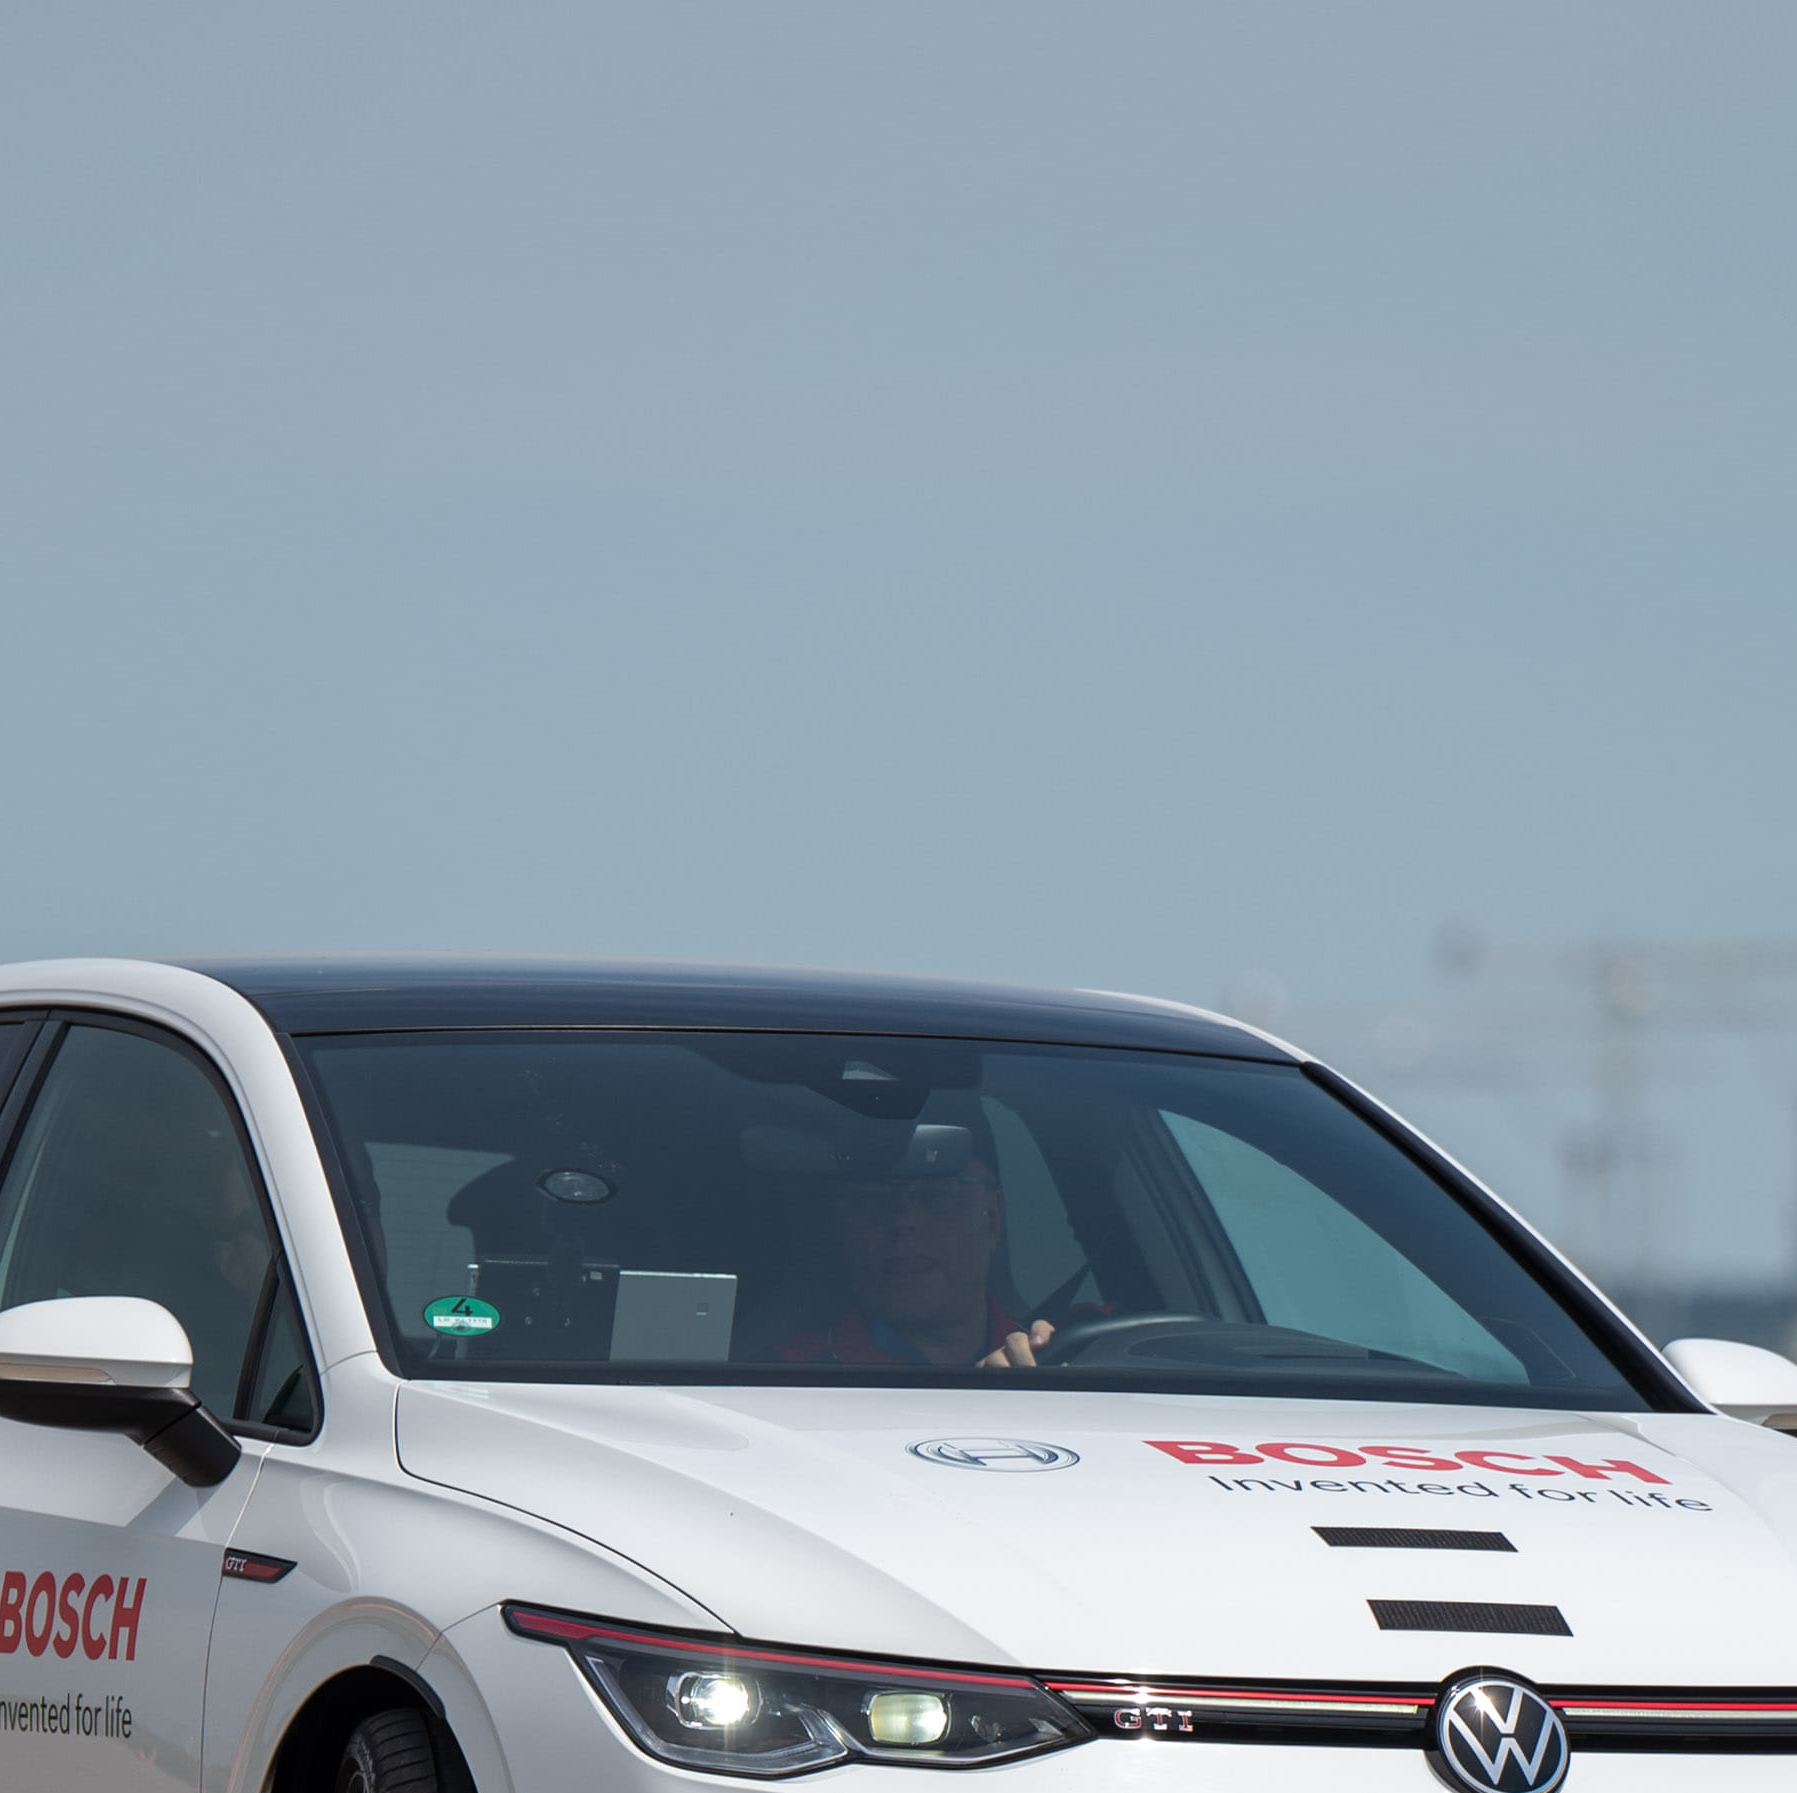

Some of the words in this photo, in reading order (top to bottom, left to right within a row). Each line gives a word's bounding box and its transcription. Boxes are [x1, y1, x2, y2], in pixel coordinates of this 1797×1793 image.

[450, 1298, 474, 1317] 4
[1142, 1440, 1674, 1485] BOSCH
[1208, 1475, 1500, 1500] Invented
[1510, 1483, 1599, 1503] for
[1609, 1490, 1714, 1513] life
[225, 1556, 248, 1572] GTI
[75, 1693, 102, 1737] for
[104, 1695, 133, 1739] life
[1114, 1707, 1194, 1732] GTI
